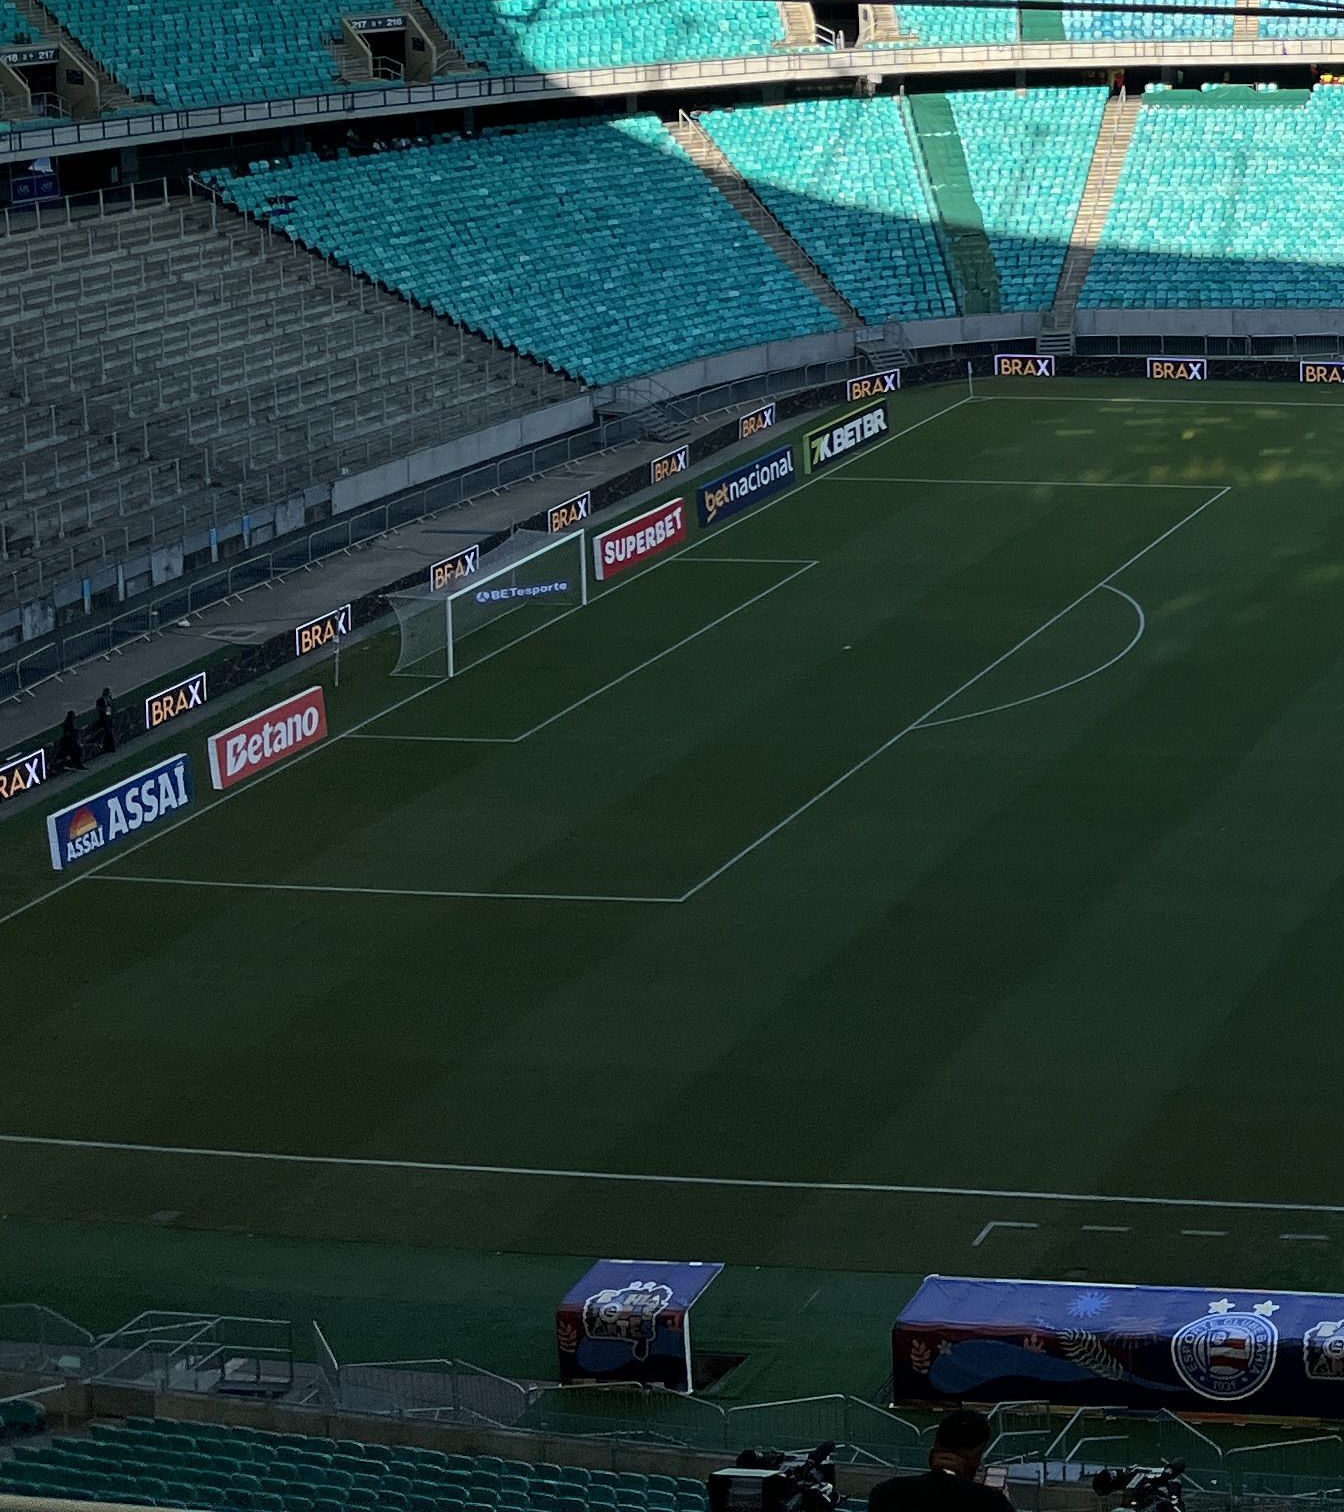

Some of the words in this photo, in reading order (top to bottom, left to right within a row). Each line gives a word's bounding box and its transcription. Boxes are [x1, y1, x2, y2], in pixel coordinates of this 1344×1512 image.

[1000, 358, 1051, 377] BRAX
[1152, 361, 1202, 380] BRAX
[851, 374, 896, 400] BRAX
[742, 408, 773, 438] BRAX
[655, 451, 688, 482] BRAX
[704, 449, 794, 512] betnacional
[552, 497, 588, 533] BRAX
[604, 506, 683, 565] SUPERBET
[491, 581, 568, 602] BETesporte
[301, 611, 347, 654] BRAX
[151, 680, 202, 727] BRAX
[226, 705, 320, 778] Betano
[0, 758, 40, 800] RAX
